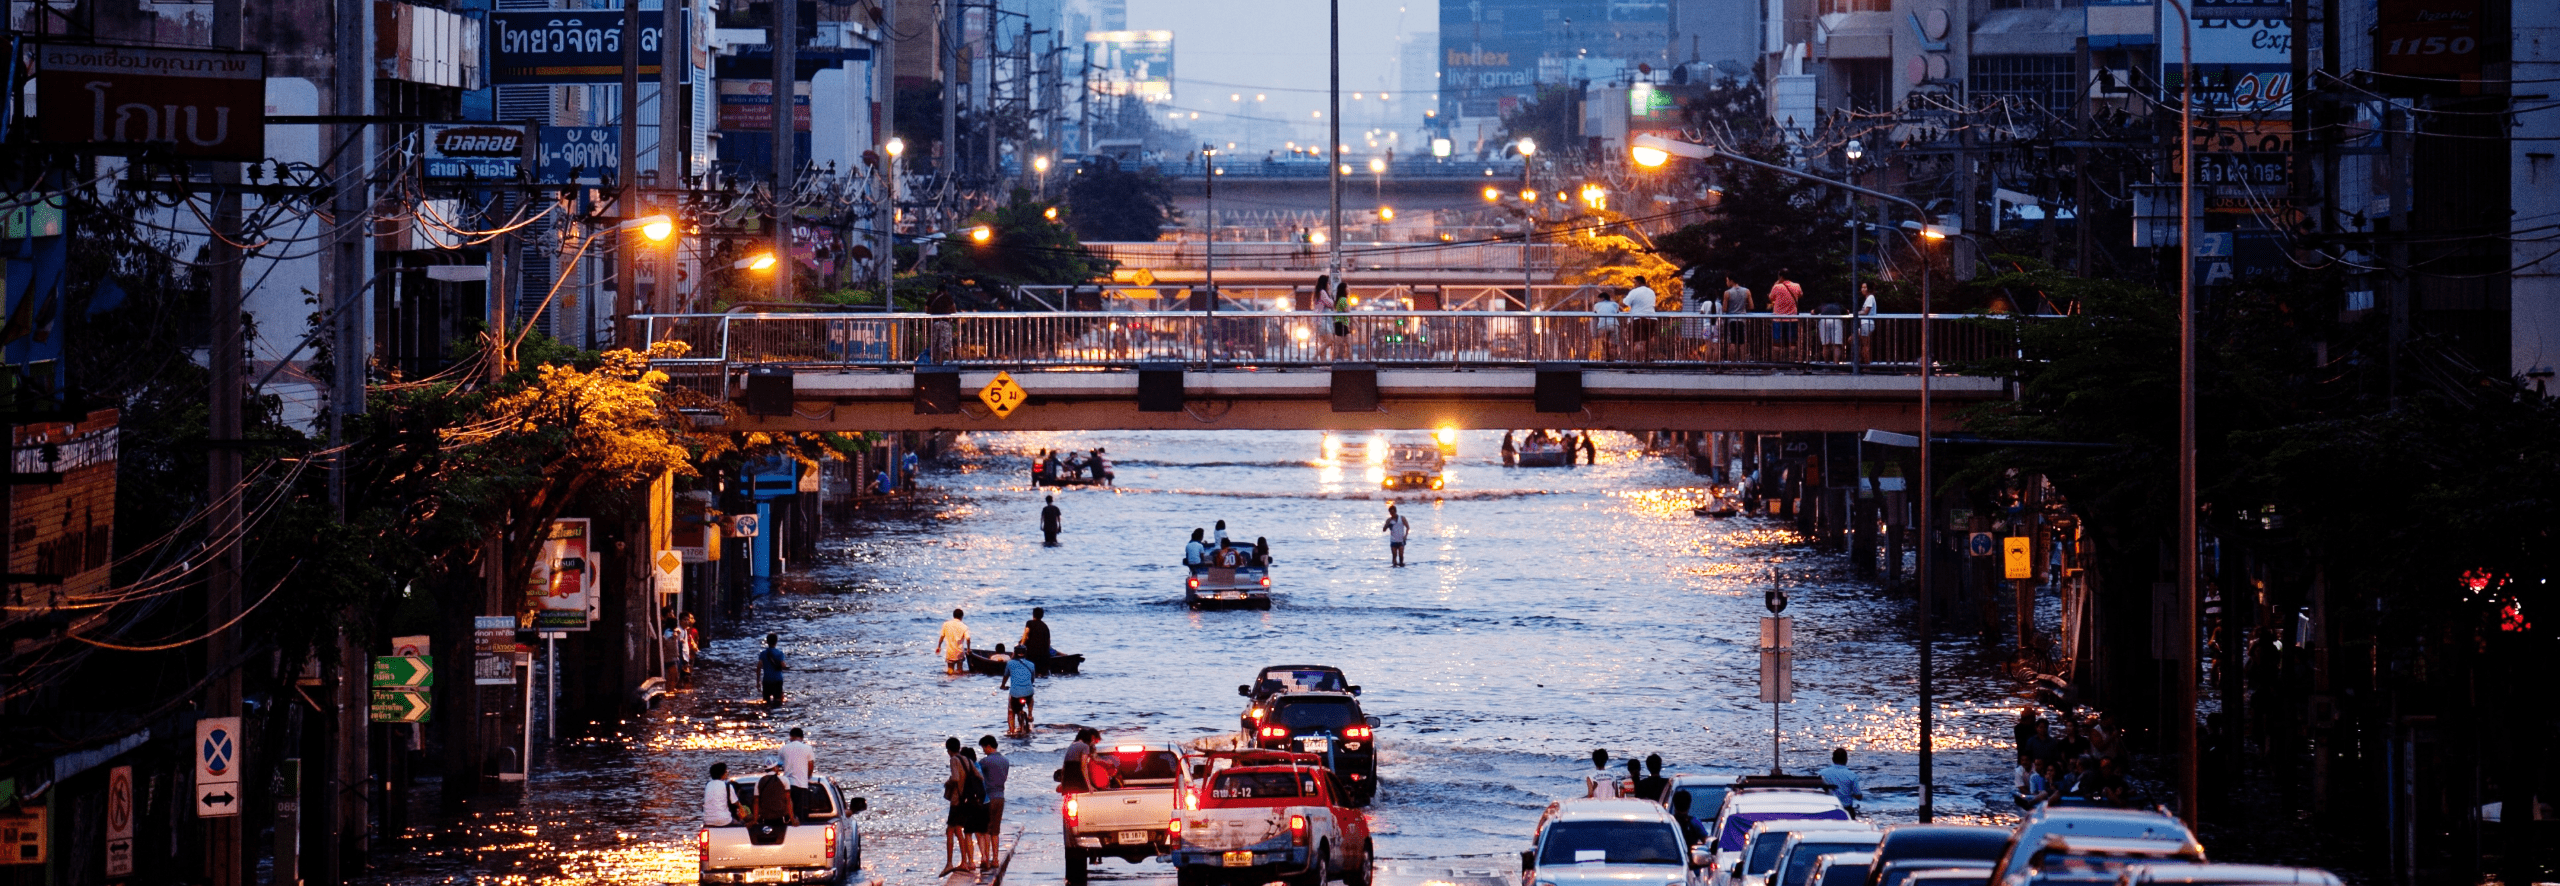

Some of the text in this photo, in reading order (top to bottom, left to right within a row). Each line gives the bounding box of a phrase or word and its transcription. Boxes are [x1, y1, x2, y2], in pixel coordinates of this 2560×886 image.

[2387, 36, 2476, 56] 1150
[48, 51, 246, 74] ลวดเชื่อมคุณภาพ
[1447, 48, 1509, 67] Inex
[84, 80, 231, 147] โกเบ
[990, 387, 1017, 403] 5 ม
